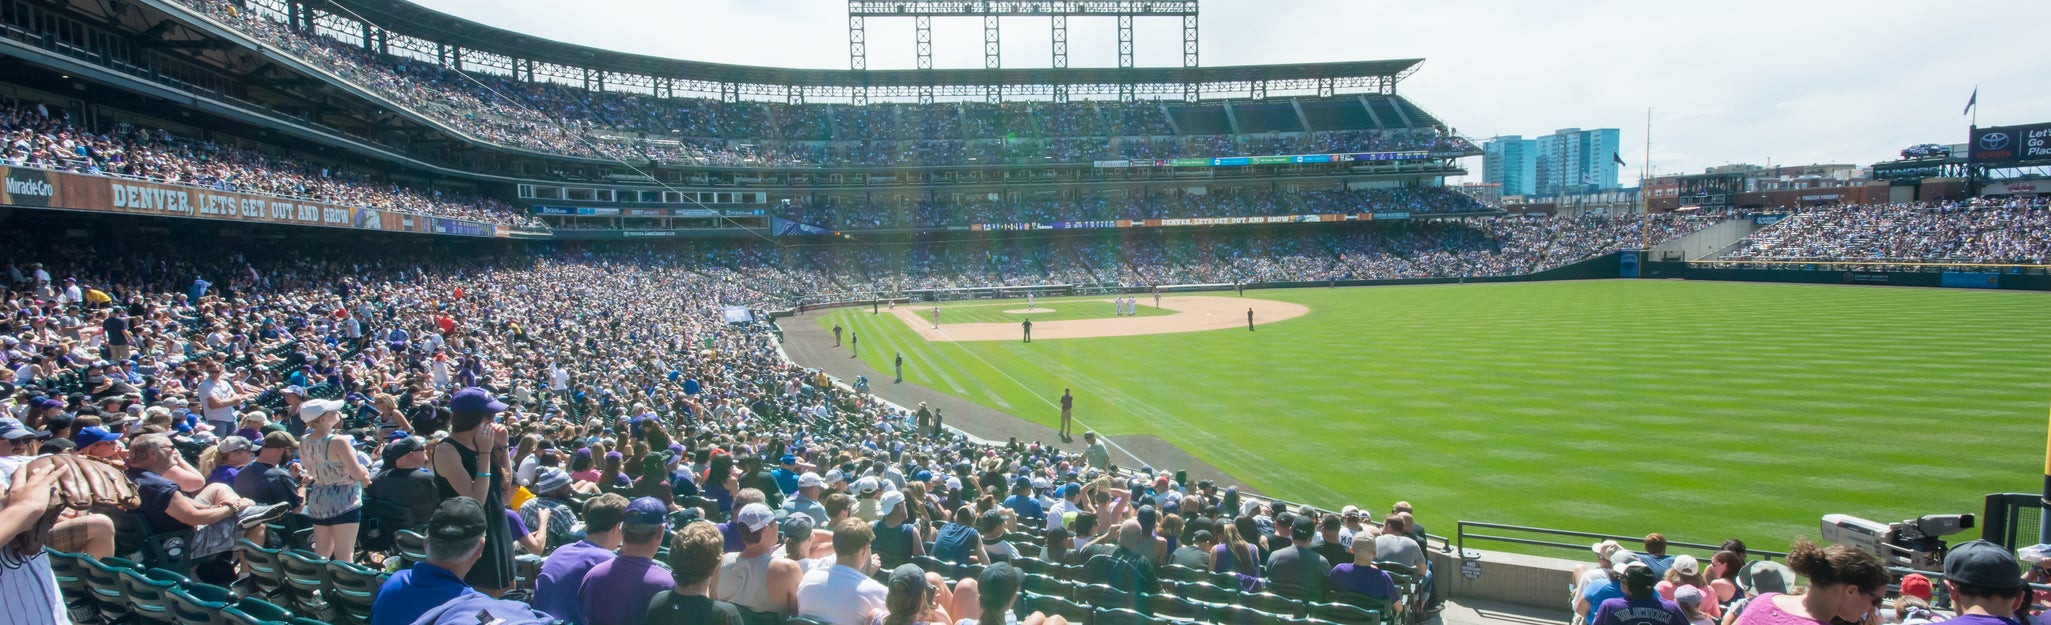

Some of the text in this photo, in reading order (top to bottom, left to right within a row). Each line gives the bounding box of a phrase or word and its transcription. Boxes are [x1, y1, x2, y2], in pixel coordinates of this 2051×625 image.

[2028, 138, 2044, 147] Go
[112, 183, 350, 225] DENVER, LETS GET OUT AND GROW
